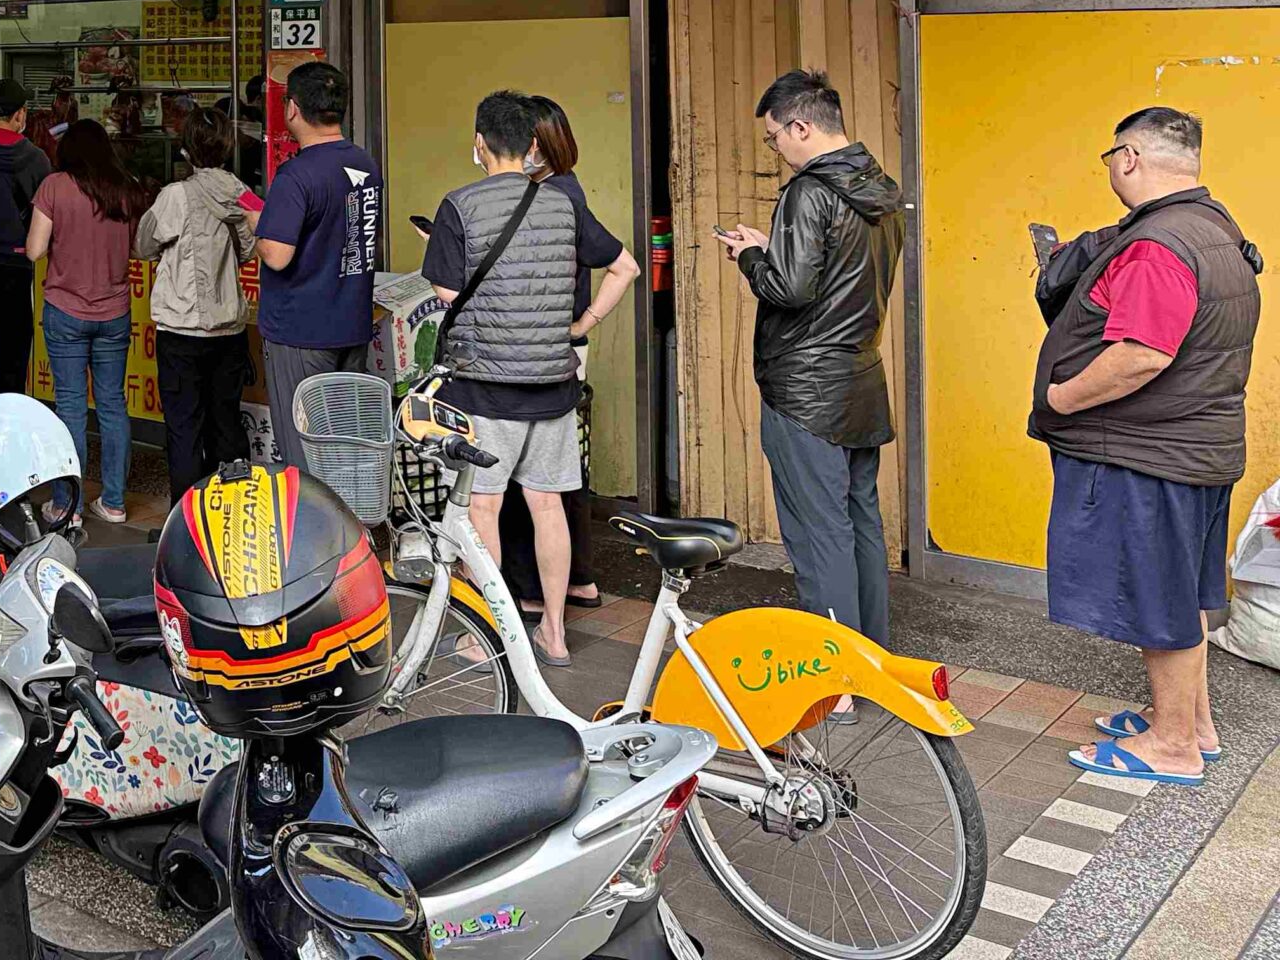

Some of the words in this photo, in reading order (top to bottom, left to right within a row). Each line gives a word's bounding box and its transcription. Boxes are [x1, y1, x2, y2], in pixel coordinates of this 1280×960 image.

[272, 12, 281, 46] 永和區
[285, 9, 316, 19] 保平路
[287, 23, 316, 46] 32
[346, 190, 363, 276] RUNNER
[362, 186, 376, 272] RUNNER
[234, 664, 328, 689] ASTONE
[429, 904, 527, 939] CHERRY
